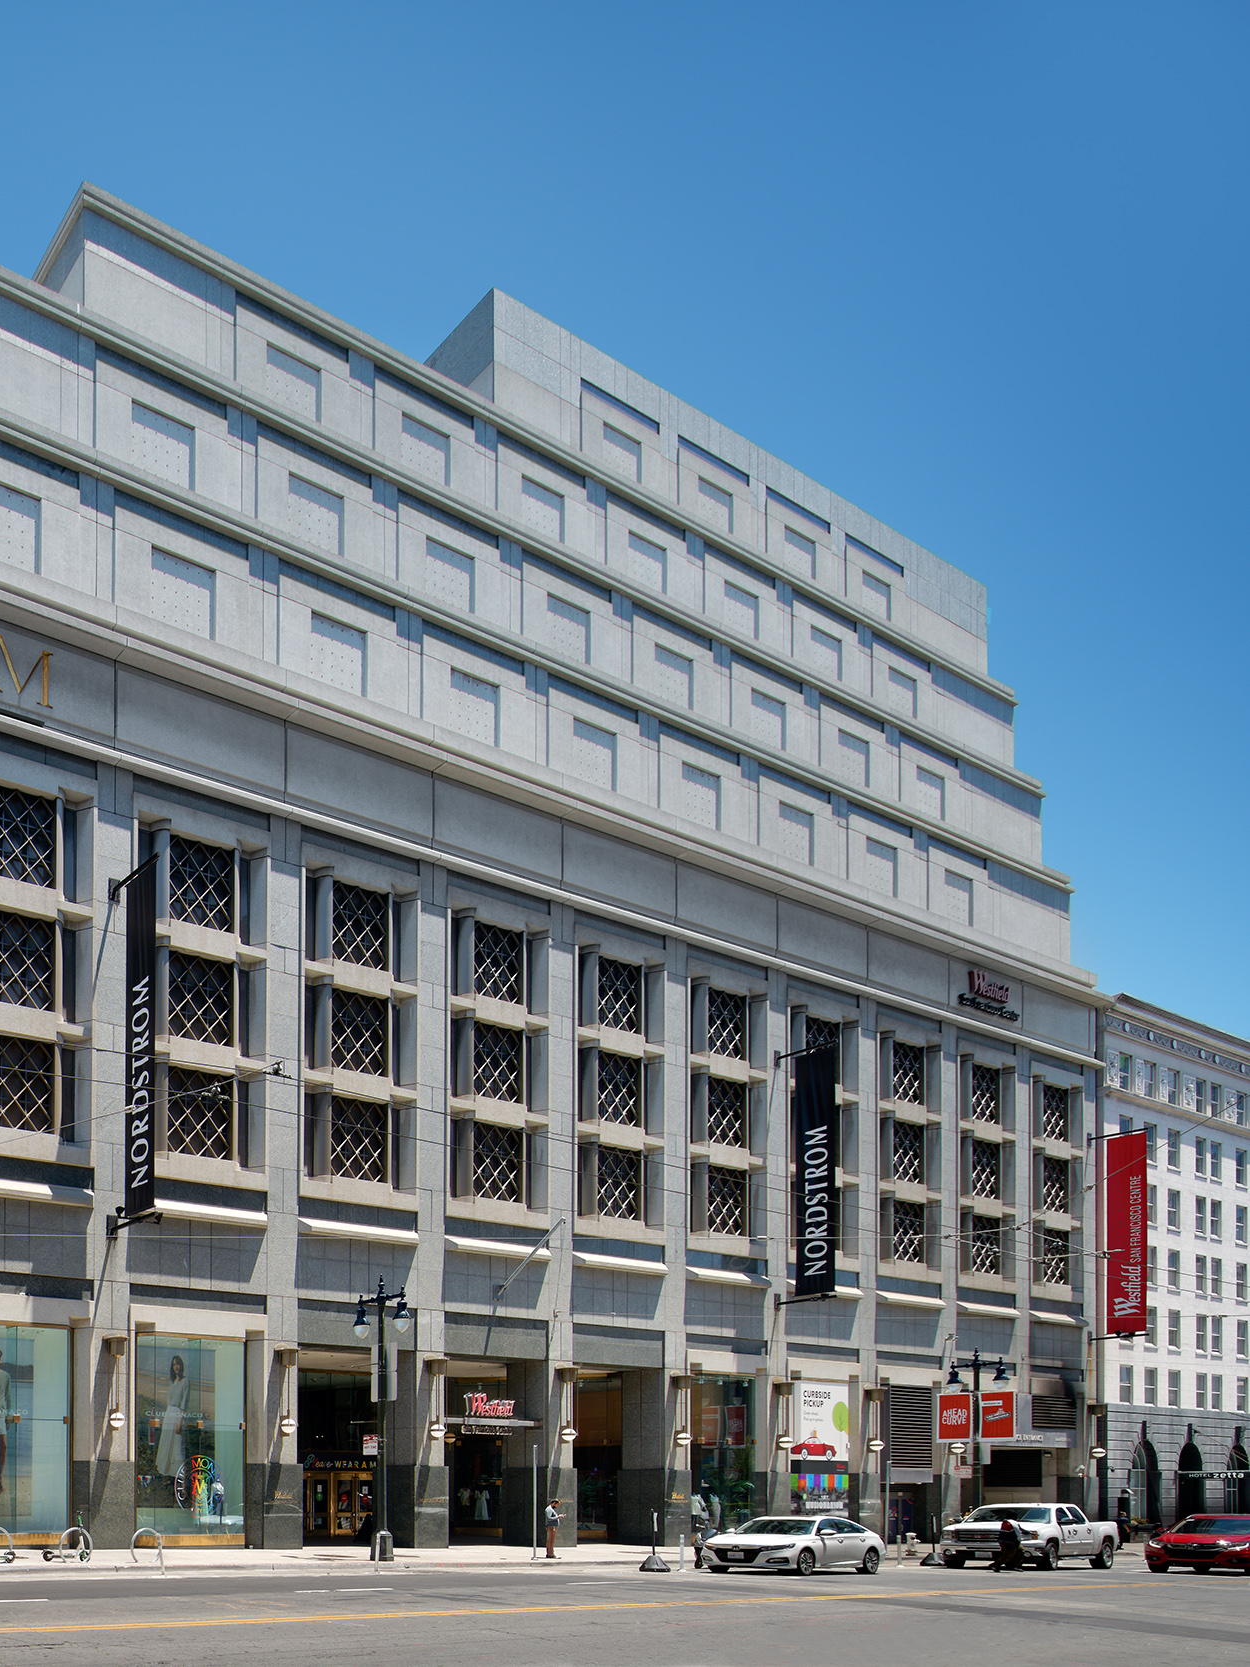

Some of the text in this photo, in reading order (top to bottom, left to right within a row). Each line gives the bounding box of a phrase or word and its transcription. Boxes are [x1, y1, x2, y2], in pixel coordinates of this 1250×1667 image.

[969, 968, 1012, 1003] Westfield
[131, 975, 150, 1189] NORDSTROM
[804, 1125, 829, 1276] NORDSTROM
[1113, 1174, 1142, 1318] Westfield SAN FRANCISCO CENTRE
[463, 1391, 516, 1417] Westfield
[803, 1390, 831, 1400] CURBSIDE
[803, 1399, 825, 1408] PICKUP
[942, 1408, 968, 1418] AHEAD
[942, 1416, 967, 1425] CURVE
[304, 1454, 333, 1469] Please
[334, 1460, 359, 1469] WEAR
[361, 1460, 368, 1469] A
